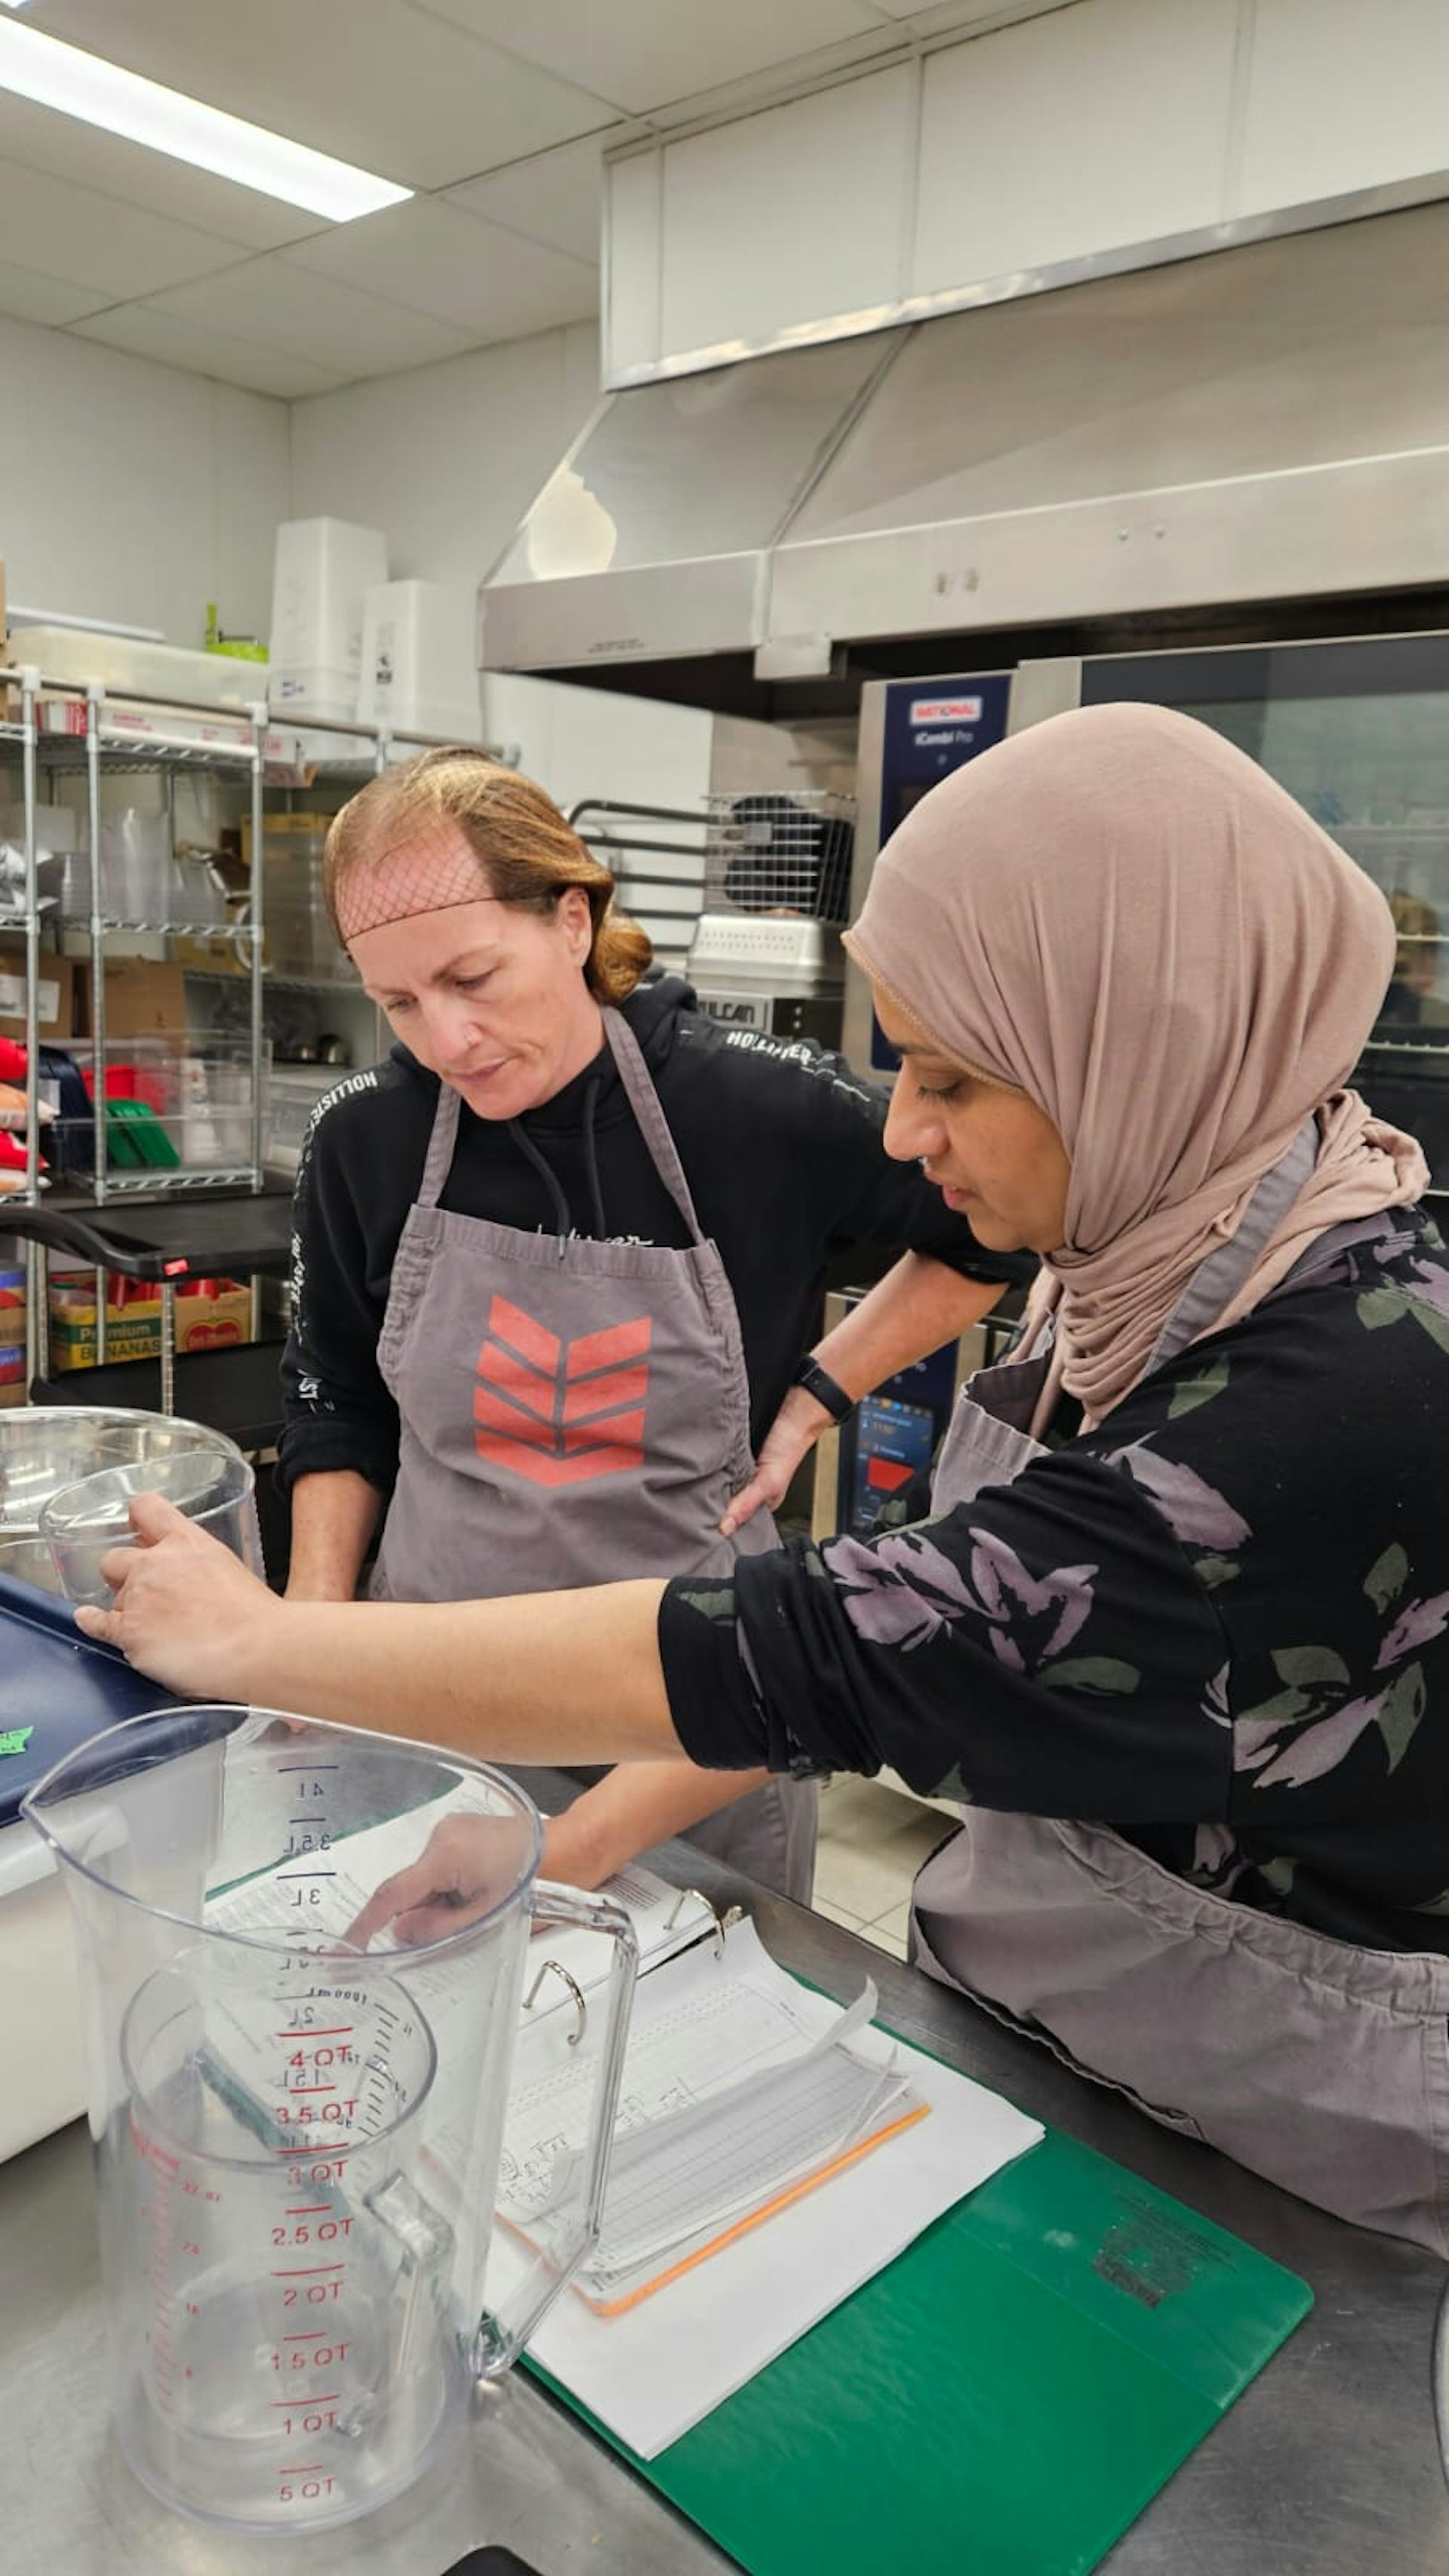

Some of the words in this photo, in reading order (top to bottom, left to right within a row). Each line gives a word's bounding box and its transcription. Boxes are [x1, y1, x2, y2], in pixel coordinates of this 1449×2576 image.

[290, 2050, 303, 2067] 4
[272, 2226, 310, 2246] 2.5
[284, 2288, 297, 2307] 2
